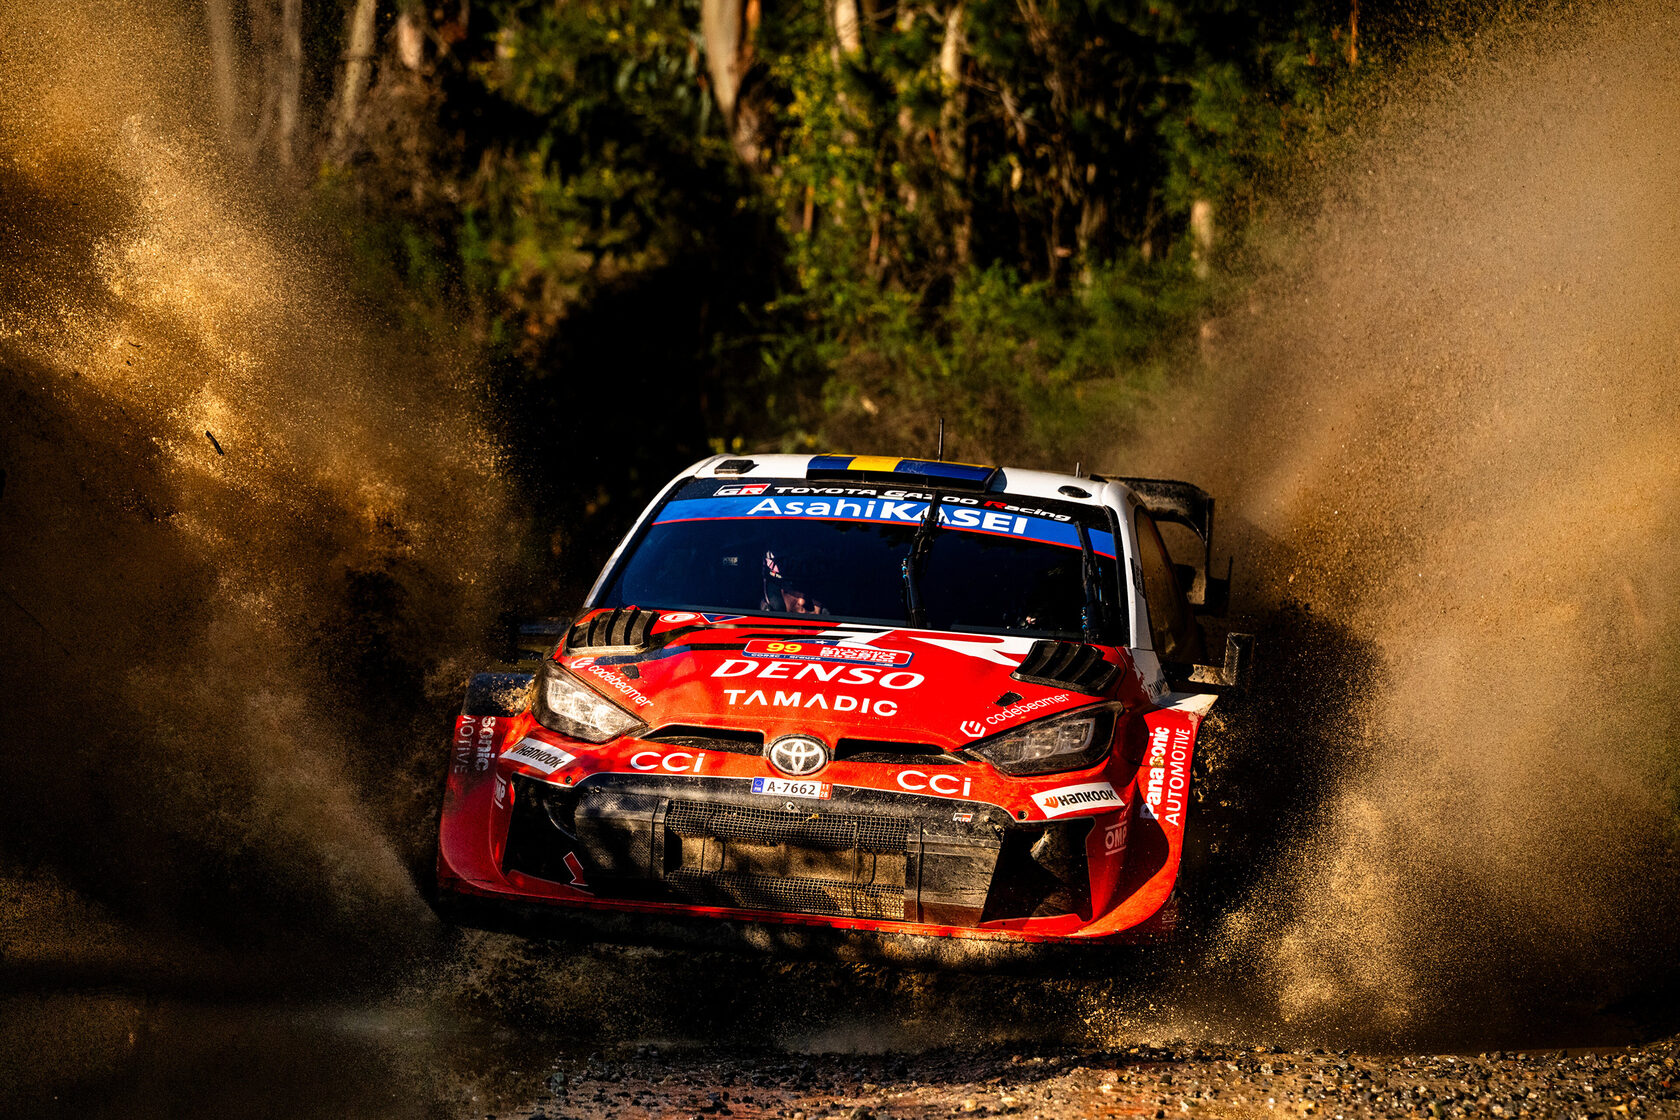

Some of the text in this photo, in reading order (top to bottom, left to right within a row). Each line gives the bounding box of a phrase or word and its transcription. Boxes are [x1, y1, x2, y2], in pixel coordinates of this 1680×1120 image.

[774, 486, 876, 496] TOYOTA
[984, 501, 1071, 522] Racing
[766, 642, 803, 654] 99
[588, 665, 652, 707] codebeamer
[710, 659, 925, 690] DENSO
[723, 689, 898, 717] TAMADIC
[986, 694, 1068, 725] codebeamer
[766, 781, 816, 795] A-7662
[1140, 726, 1170, 820] Panasonic
[1165, 728, 1191, 826] AUTOMOTIVE
[1105, 826, 1127, 850] OMP
